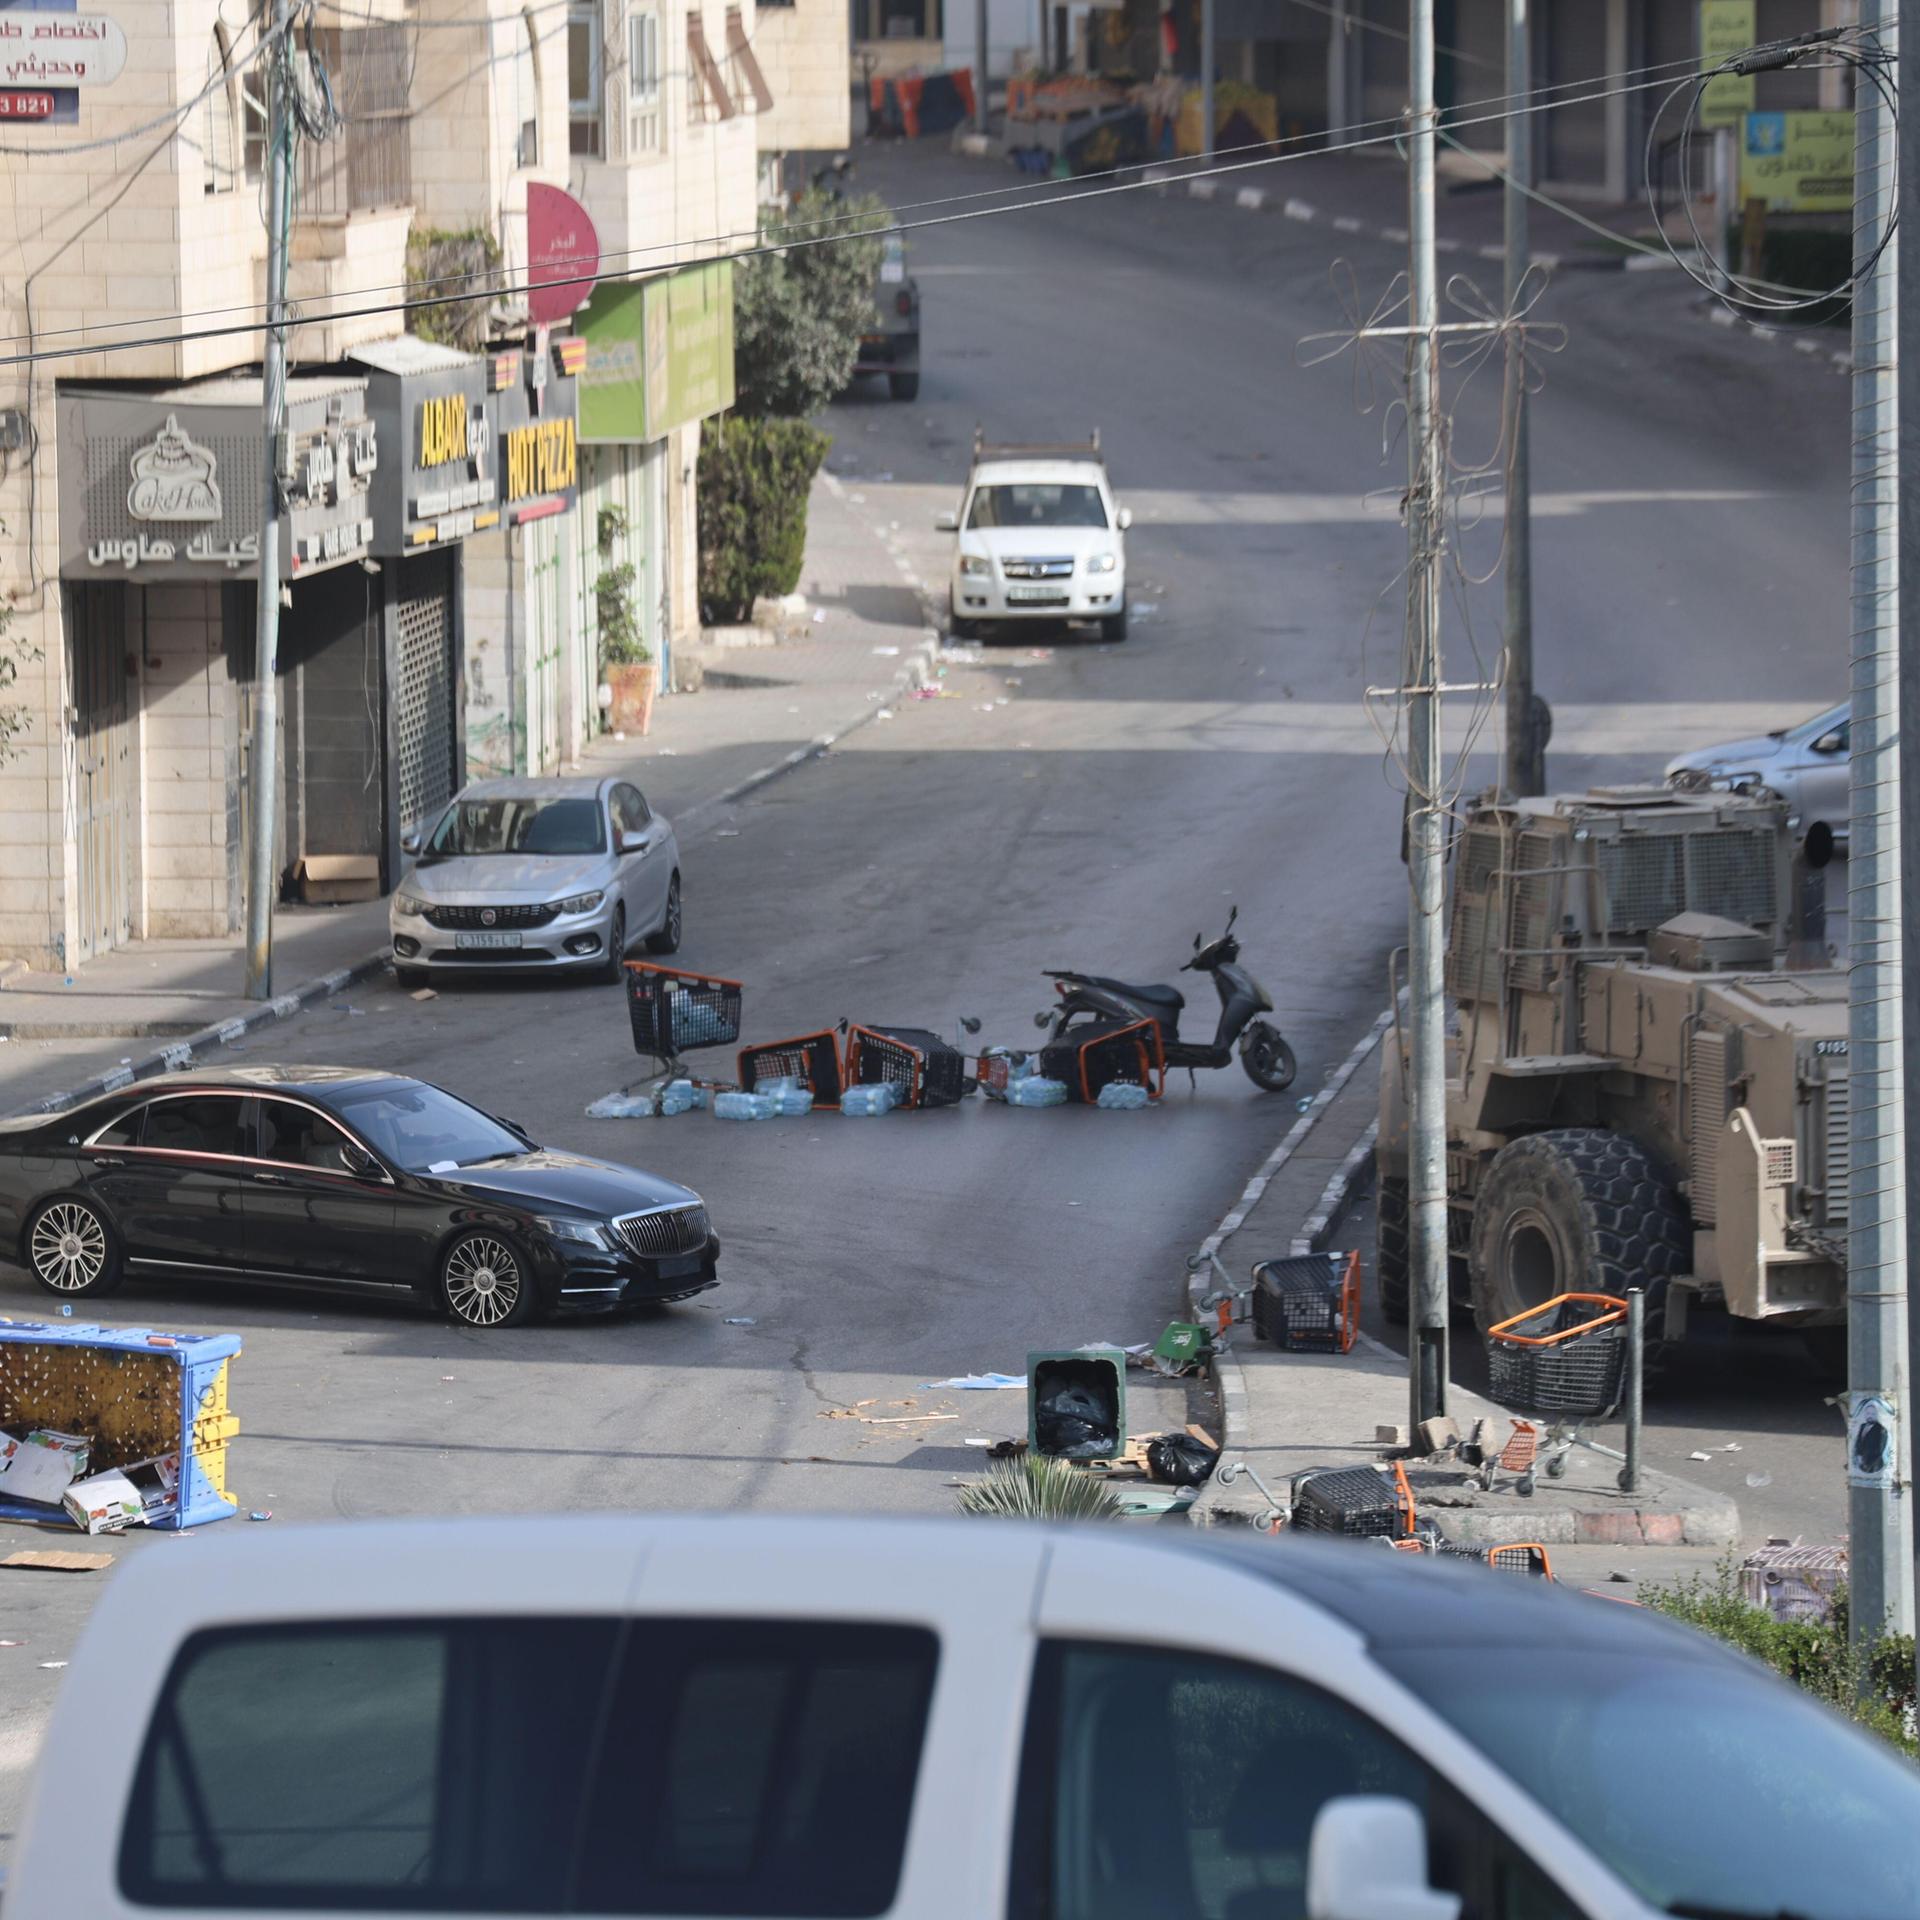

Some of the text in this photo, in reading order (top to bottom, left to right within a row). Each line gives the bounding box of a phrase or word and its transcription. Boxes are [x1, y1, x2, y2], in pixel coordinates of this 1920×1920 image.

[29, 20, 107, 40] اختصاص
[6, 51, 86, 81] وحديثي
[421, 392, 467, 468] ALBADR
[507, 426, 536, 502] HOT
[88, 531, 260, 570] كيك هاوس
